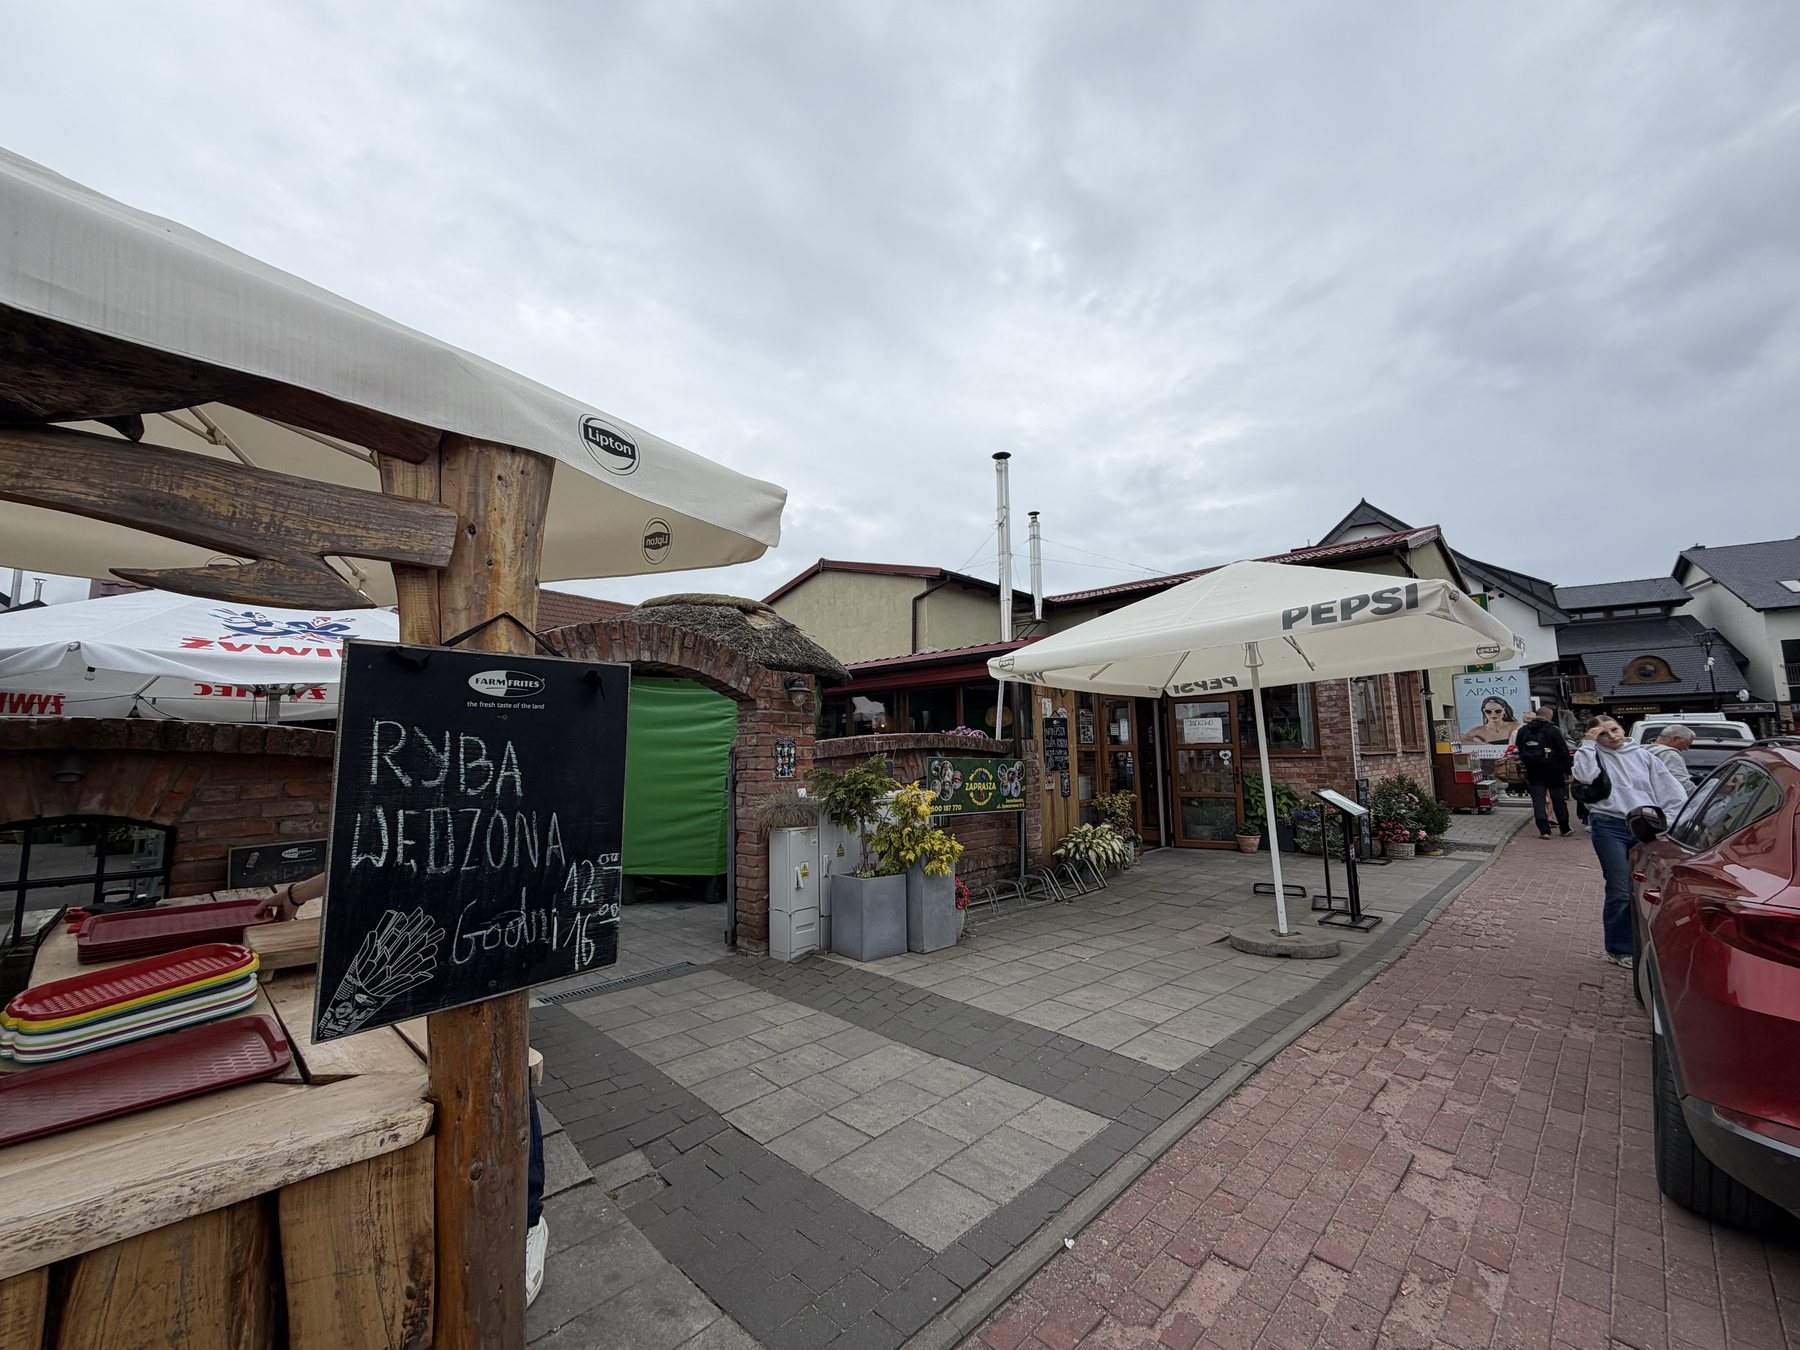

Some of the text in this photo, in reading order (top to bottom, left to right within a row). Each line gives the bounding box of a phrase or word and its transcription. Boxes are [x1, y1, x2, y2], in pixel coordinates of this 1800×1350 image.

[588, 427, 632, 456] Lipton
[1282, 582, 1419, 630] PEPSI
[179, 636, 342, 658] ŻYWI
[475, 677, 540, 688] FARM FRITES
[1466, 686, 1518, 697] APART.pl
[466, 700, 478, 708] the
[370, 719, 523, 797] RYBA
[965, 782, 996, 791] ZAPRASZA
[952, 803, 962, 811] 770
[350, 804, 566, 876] WĘDZONA
